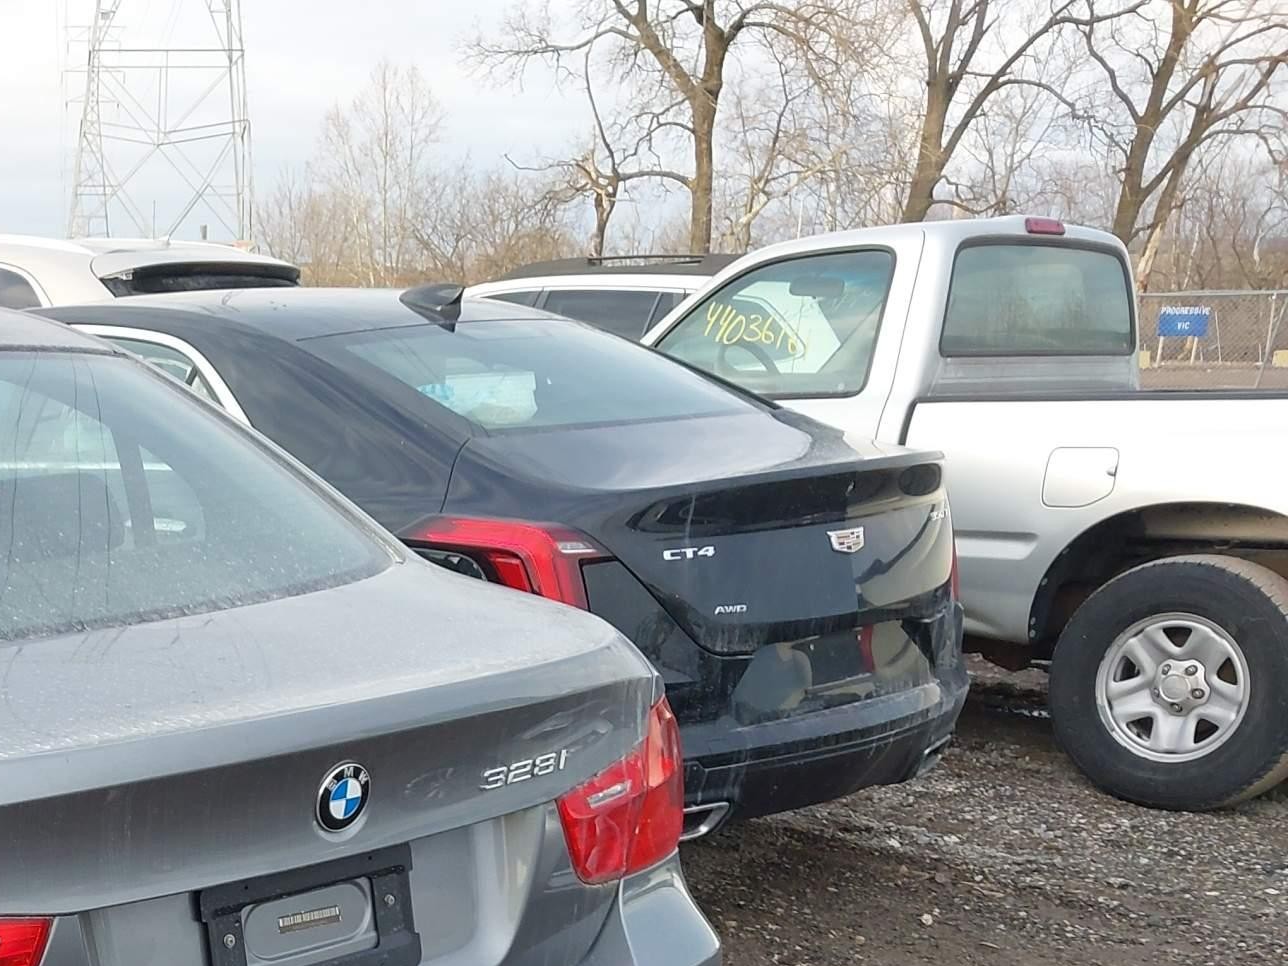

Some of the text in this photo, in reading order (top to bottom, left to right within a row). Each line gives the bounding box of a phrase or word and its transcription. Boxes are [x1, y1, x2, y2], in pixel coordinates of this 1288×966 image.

[663, 546, 715, 560] CT4
[714, 604, 747, 615] AWD
[326, 766, 369, 791] BMW
[479, 749, 567, 790] 328i
